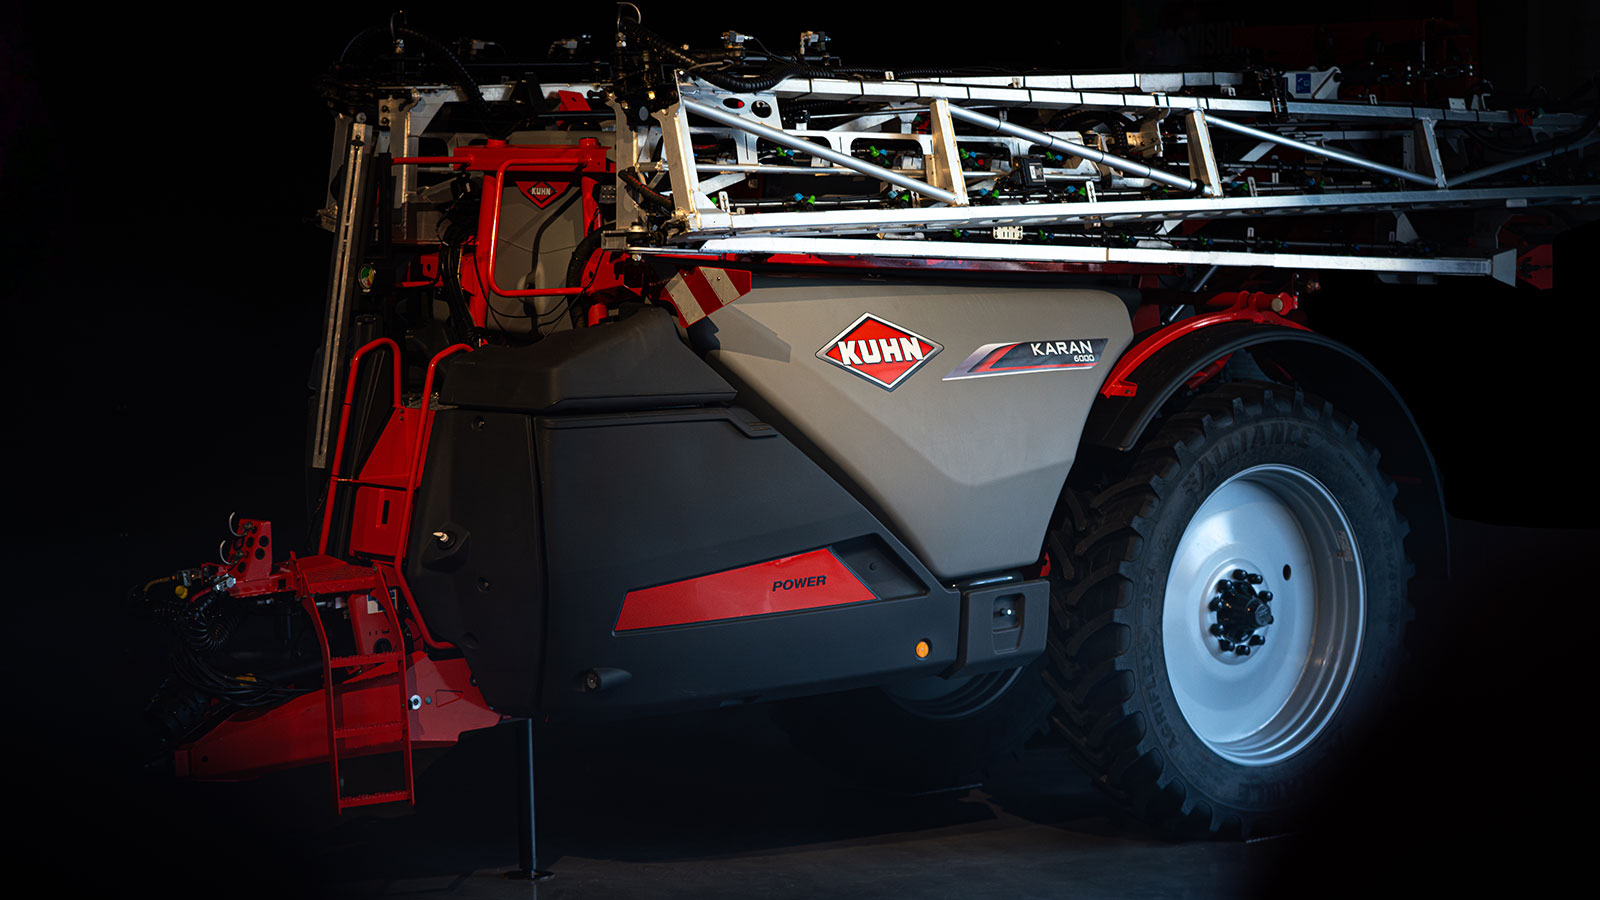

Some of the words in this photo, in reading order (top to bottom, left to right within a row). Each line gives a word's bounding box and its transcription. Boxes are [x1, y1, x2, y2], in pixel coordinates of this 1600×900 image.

[531, 187, 552, 196] KUHN
[838, 337, 924, 367] KUHN
[1031, 340, 1093, 357] KARAN
[1074, 354, 1096, 363] 6000
[772, 575, 827, 592] POWER
